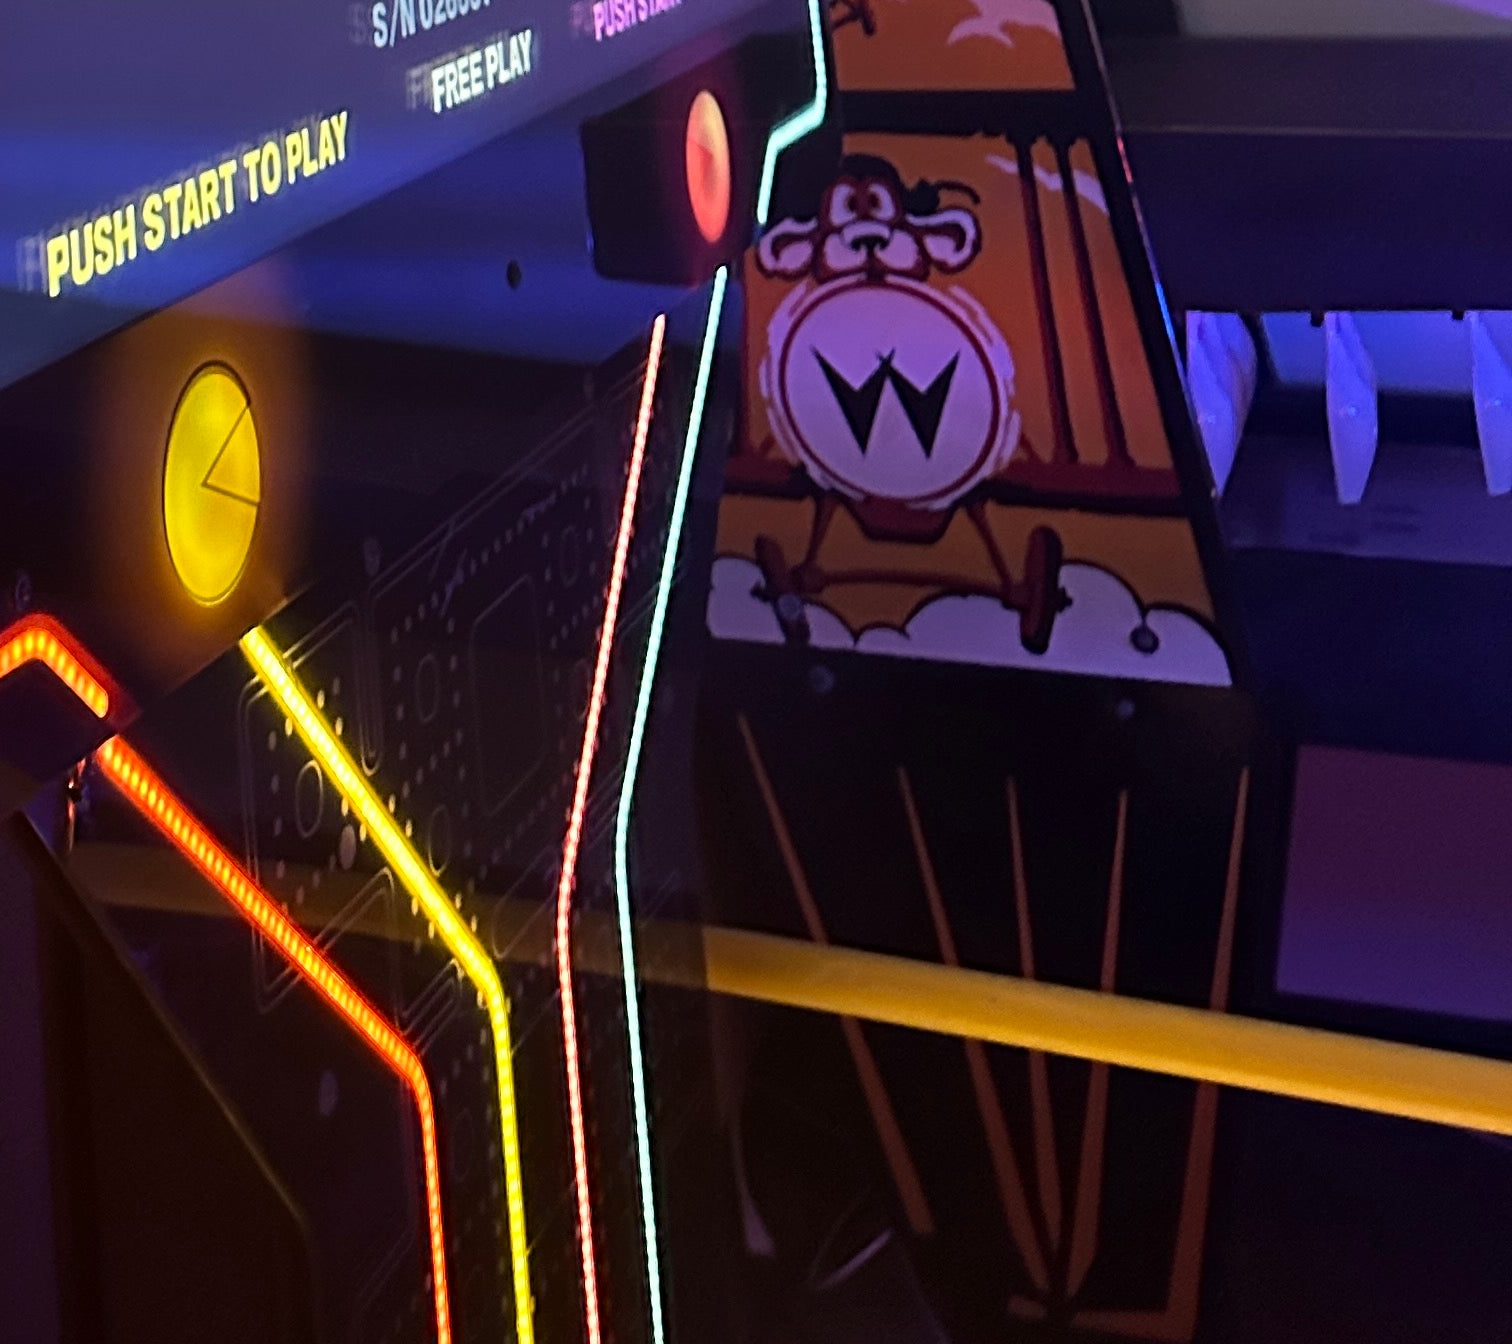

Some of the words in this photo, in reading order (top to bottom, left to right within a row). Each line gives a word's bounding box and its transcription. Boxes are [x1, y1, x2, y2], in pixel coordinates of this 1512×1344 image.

[431, 51, 486, 113] FREE
[486, 29, 532, 90] PLAY
[46, 204, 138, 298] PUSH
[142, 159, 237, 251] START
[242, 141, 282, 202] TO
[285, 111, 348, 185] PLAY
